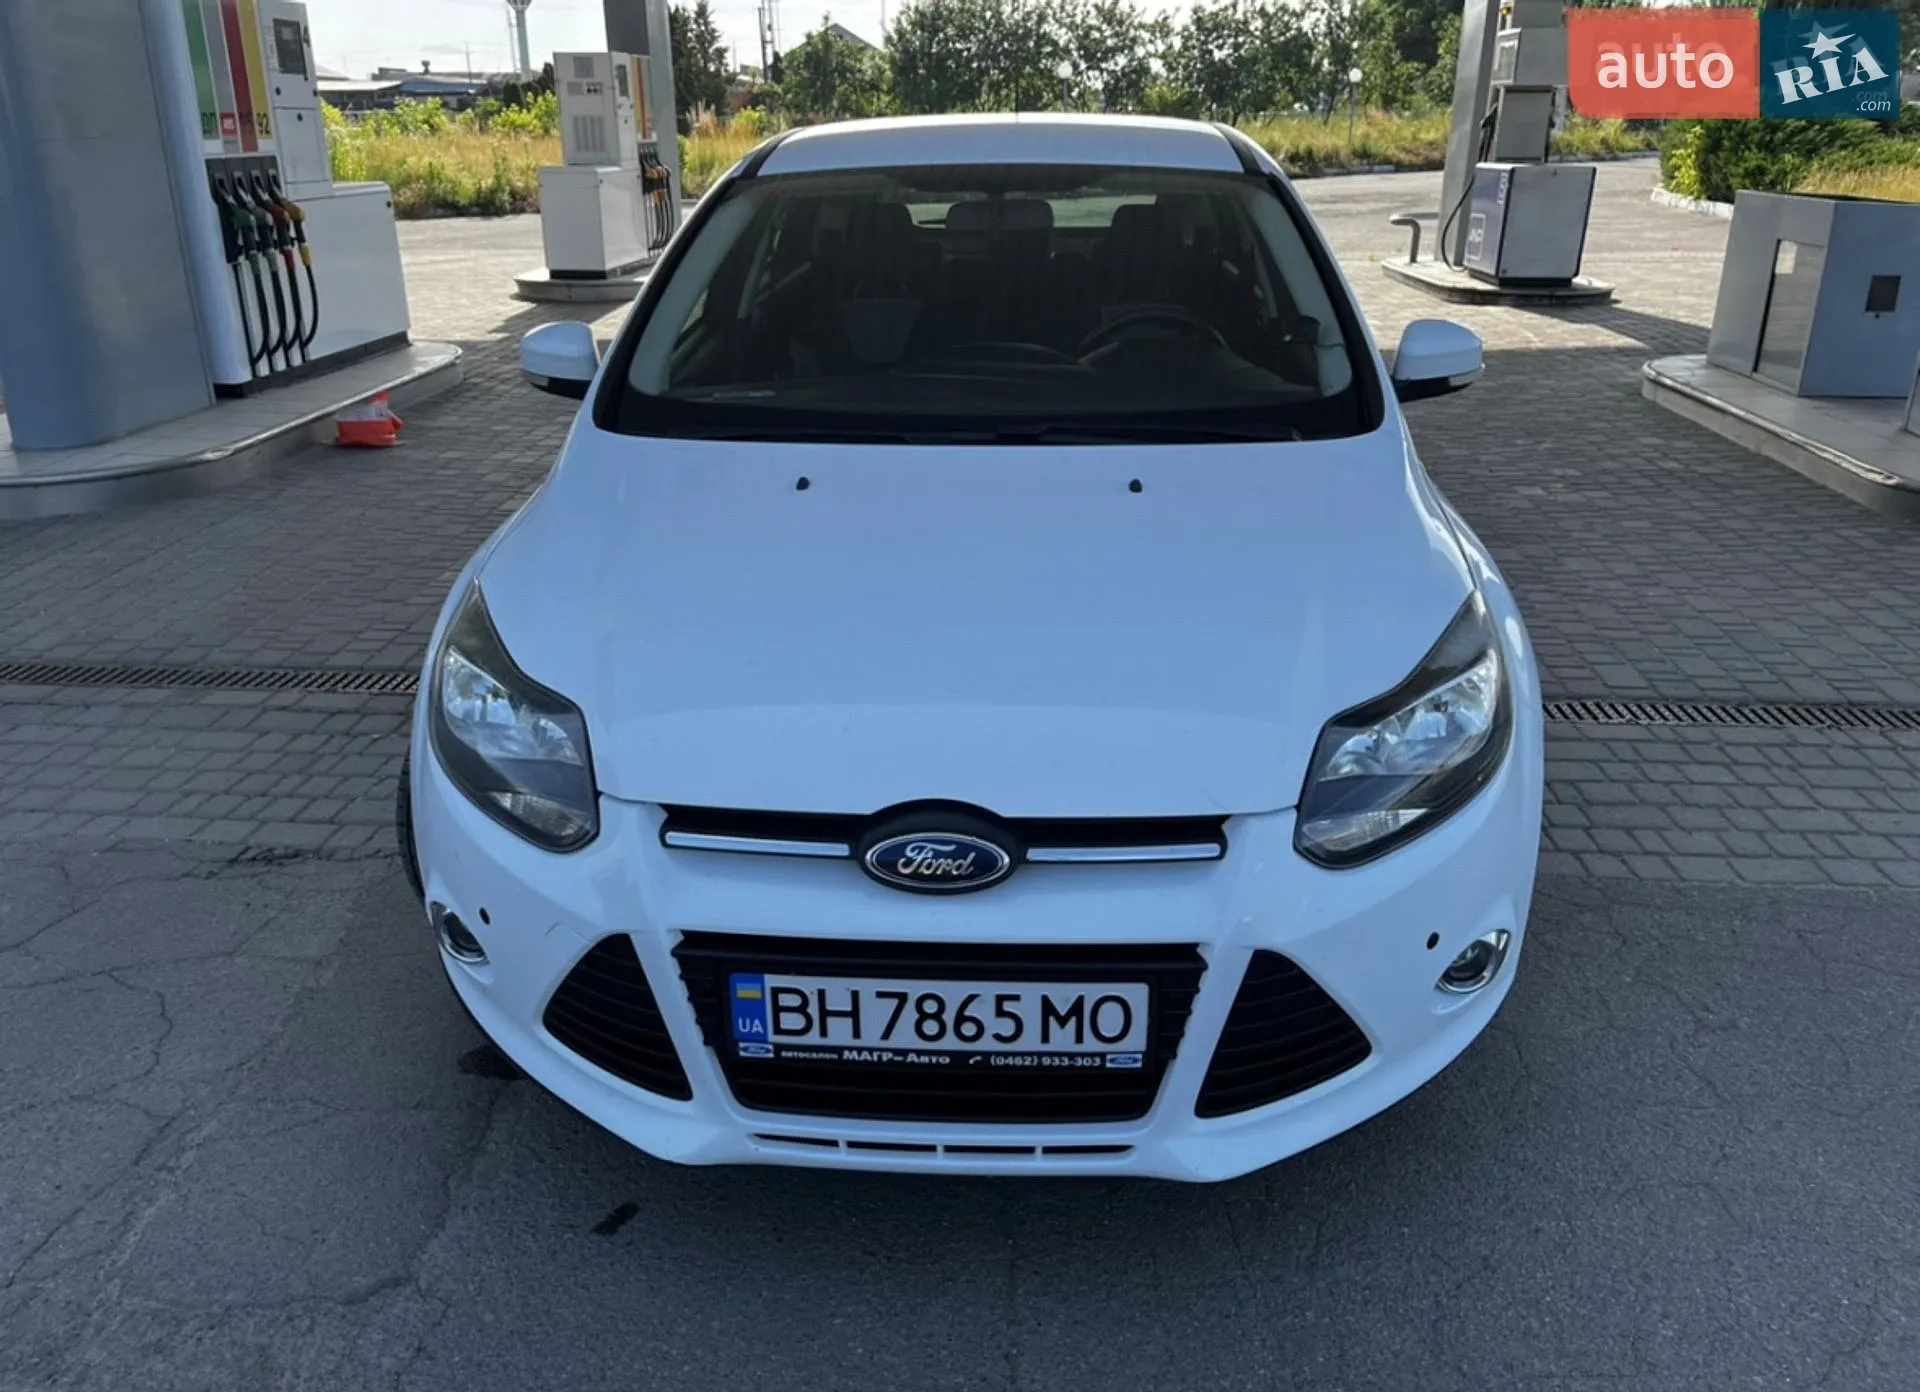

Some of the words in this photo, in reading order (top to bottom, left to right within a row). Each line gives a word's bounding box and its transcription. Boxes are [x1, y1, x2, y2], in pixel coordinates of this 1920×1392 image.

[897, 842, 977, 875] Ford
[738, 1018, 764, 1034] UA
[875, 991, 1024, 1044] 7865
[1041, 1056, 1101, 1067] 933-303
